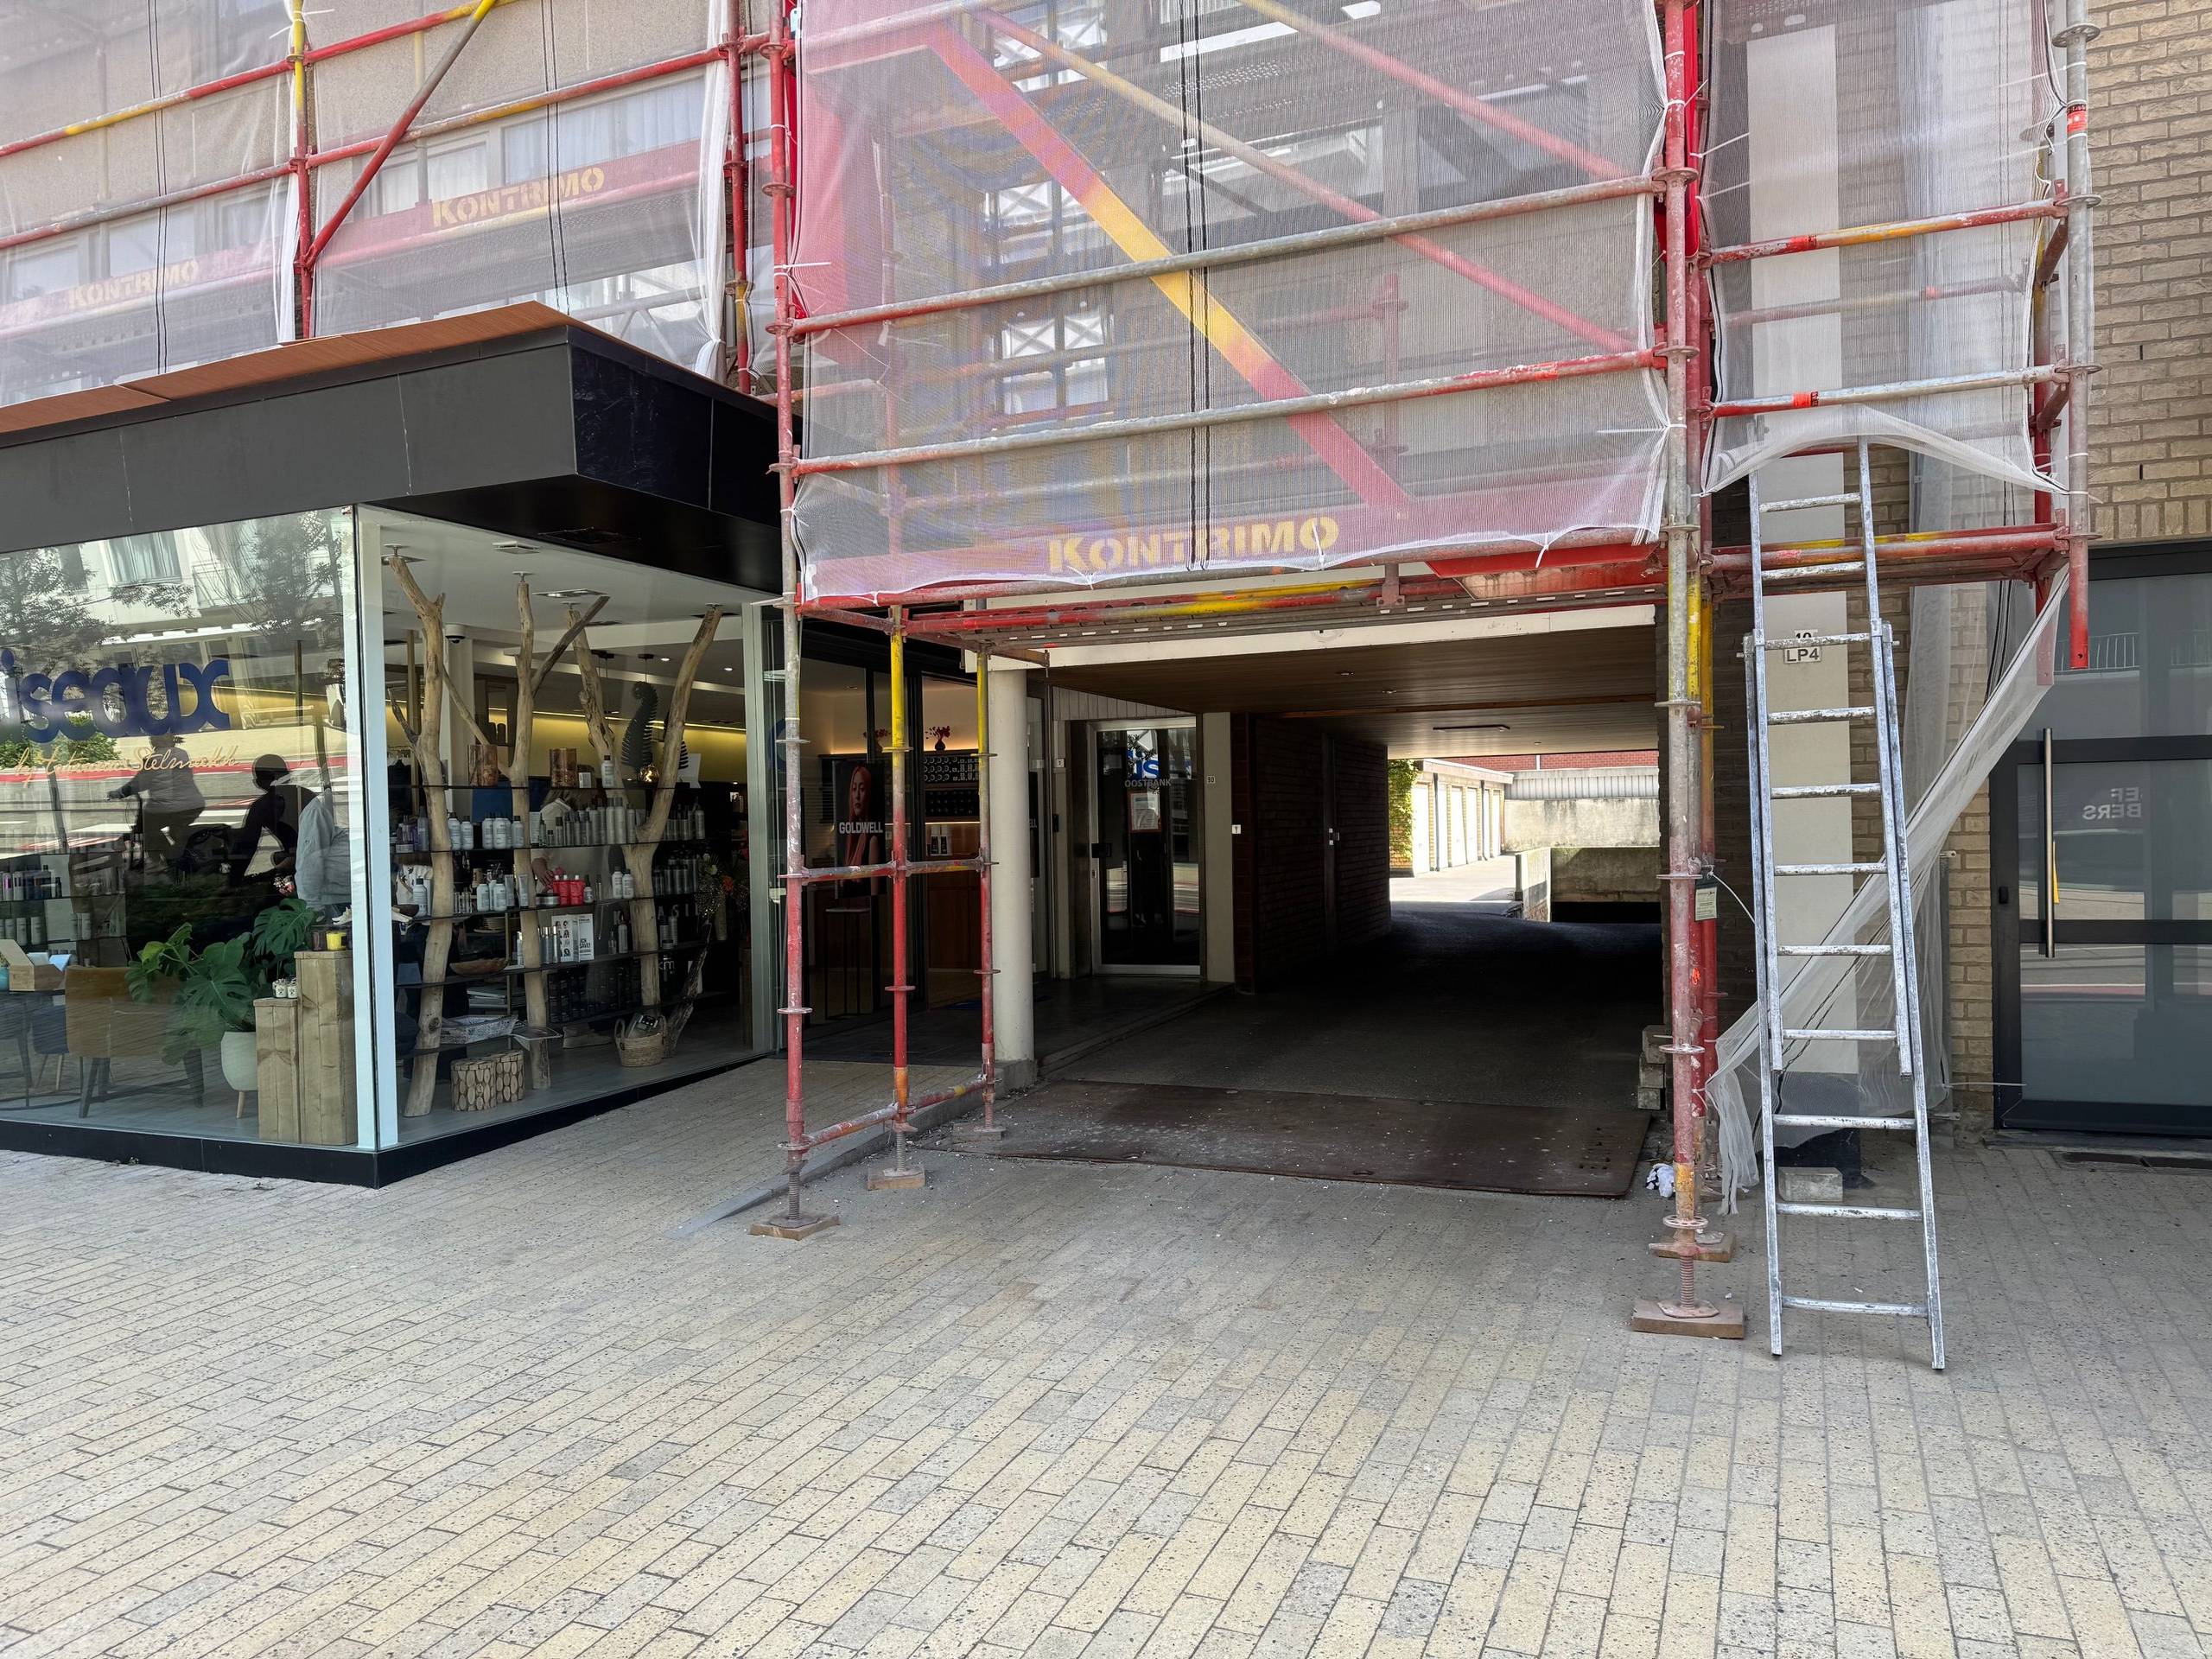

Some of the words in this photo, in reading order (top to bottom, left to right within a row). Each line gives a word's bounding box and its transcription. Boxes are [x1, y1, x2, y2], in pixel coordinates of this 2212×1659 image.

[432, 167, 605, 227] KONTRIMO
[69, 258, 200, 309] KONTRIMO
[1048, 516, 1338, 572] KONTRIMO
[1786, 647, 1820, 662] LP4
[1124, 779, 1172, 788] OOSTBANK
[839, 822, 883, 834] GOLDWELL
